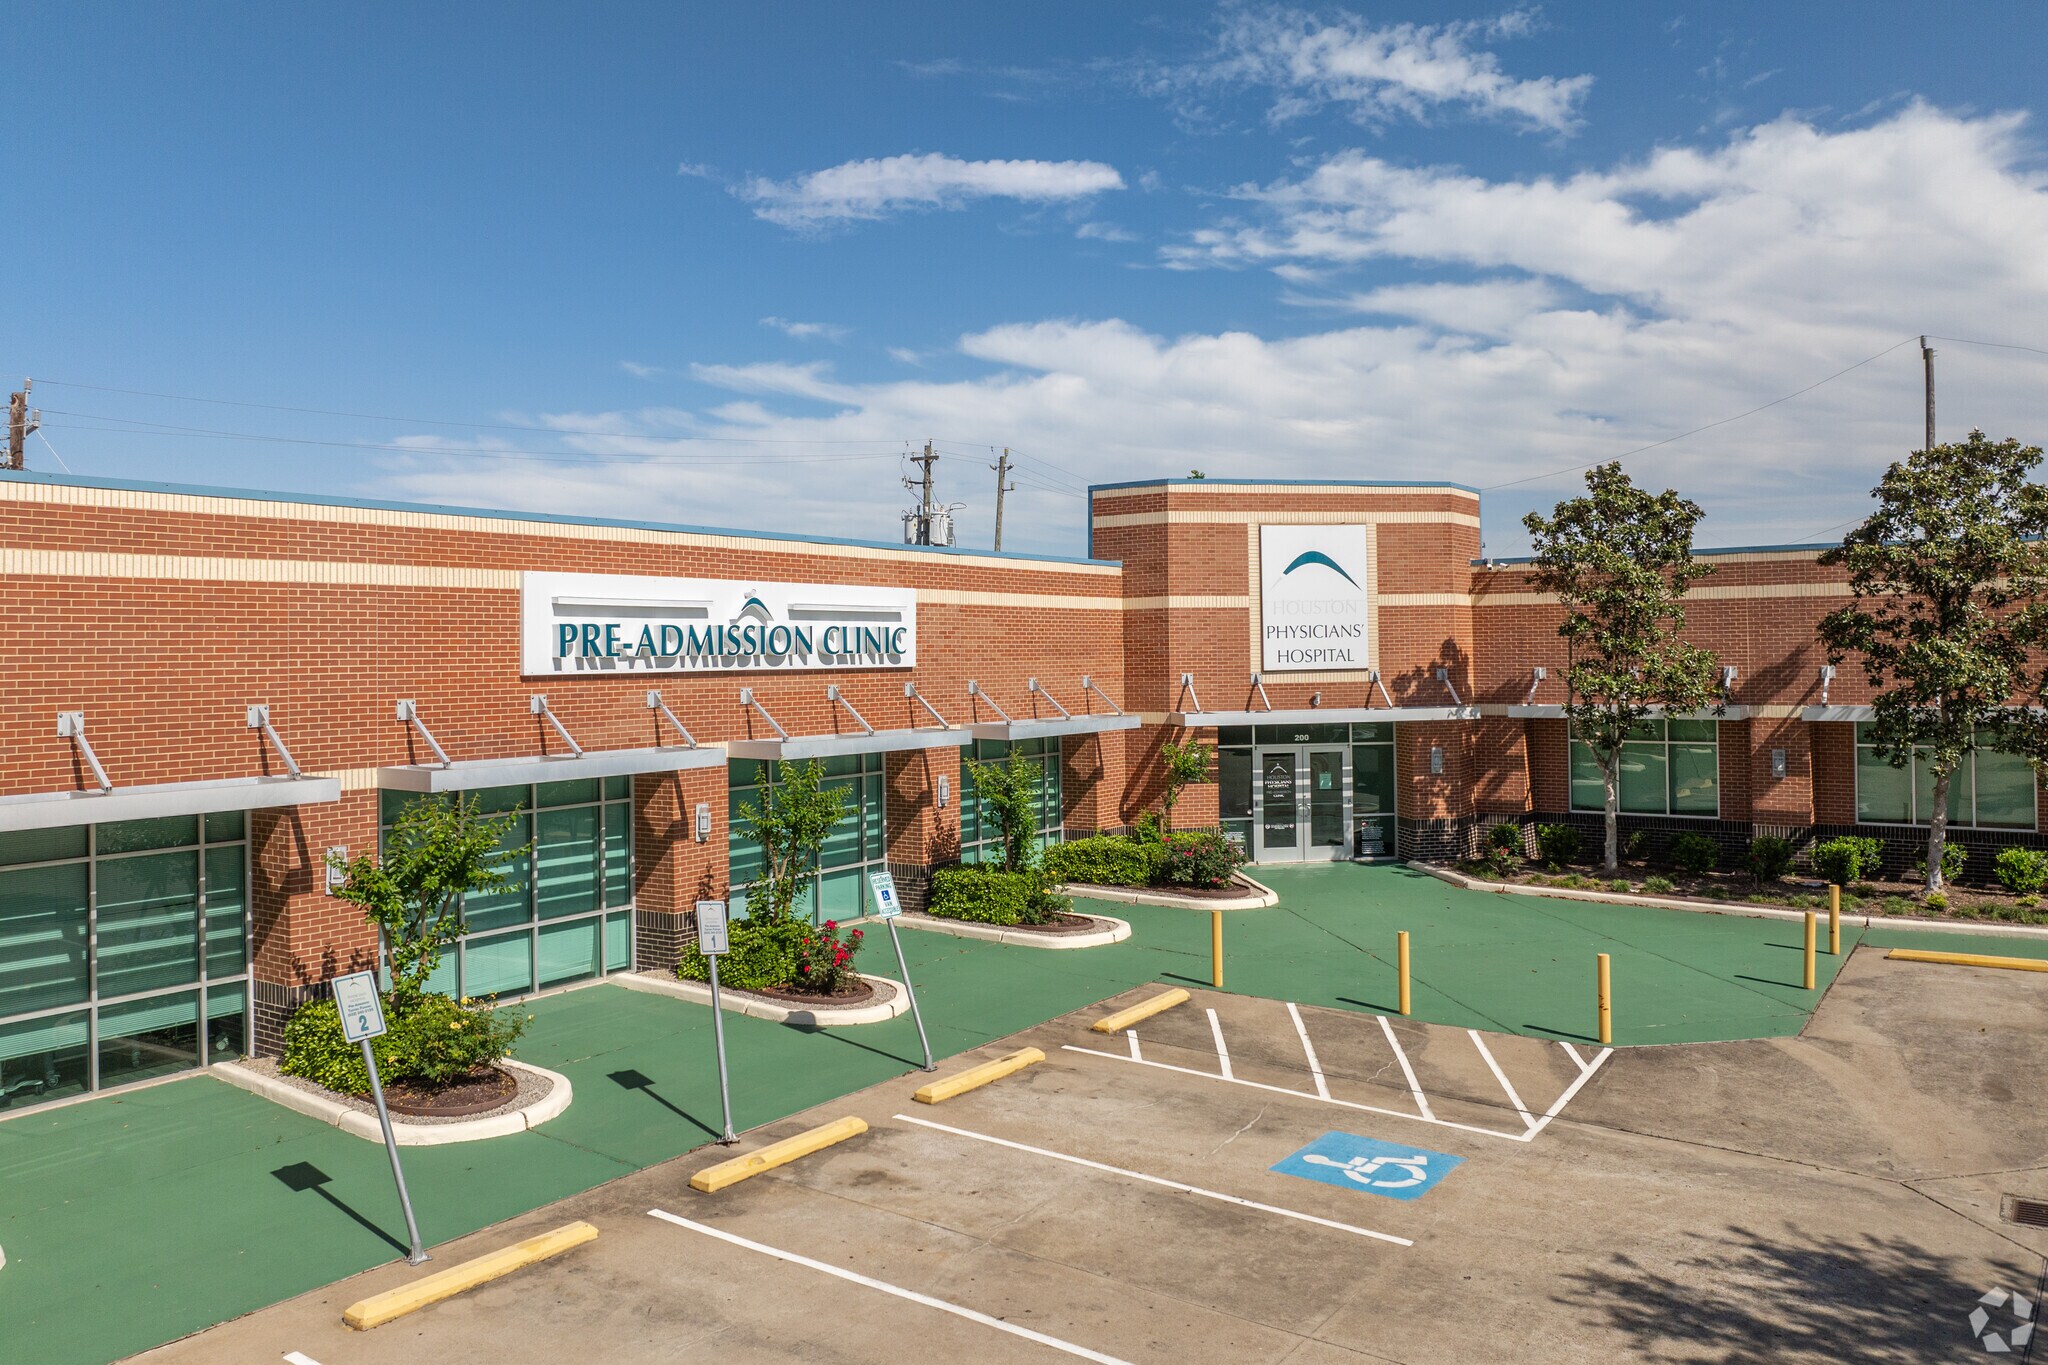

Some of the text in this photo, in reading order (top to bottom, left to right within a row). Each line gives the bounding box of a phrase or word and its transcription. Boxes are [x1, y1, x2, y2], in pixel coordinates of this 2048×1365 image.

[1273, 599, 1357, 615] HOUSTON
[1266, 624, 1365, 639] PHYSICIANS'
[559, 623, 908, 658] PRE-ADMISSION CLINIC
[1277, 648, 1355, 663] HOSPITAL
[1294, 734, 1310, 742] 200
[711, 935, 716, 948] 1
[358, 1014, 370, 1032] 2
